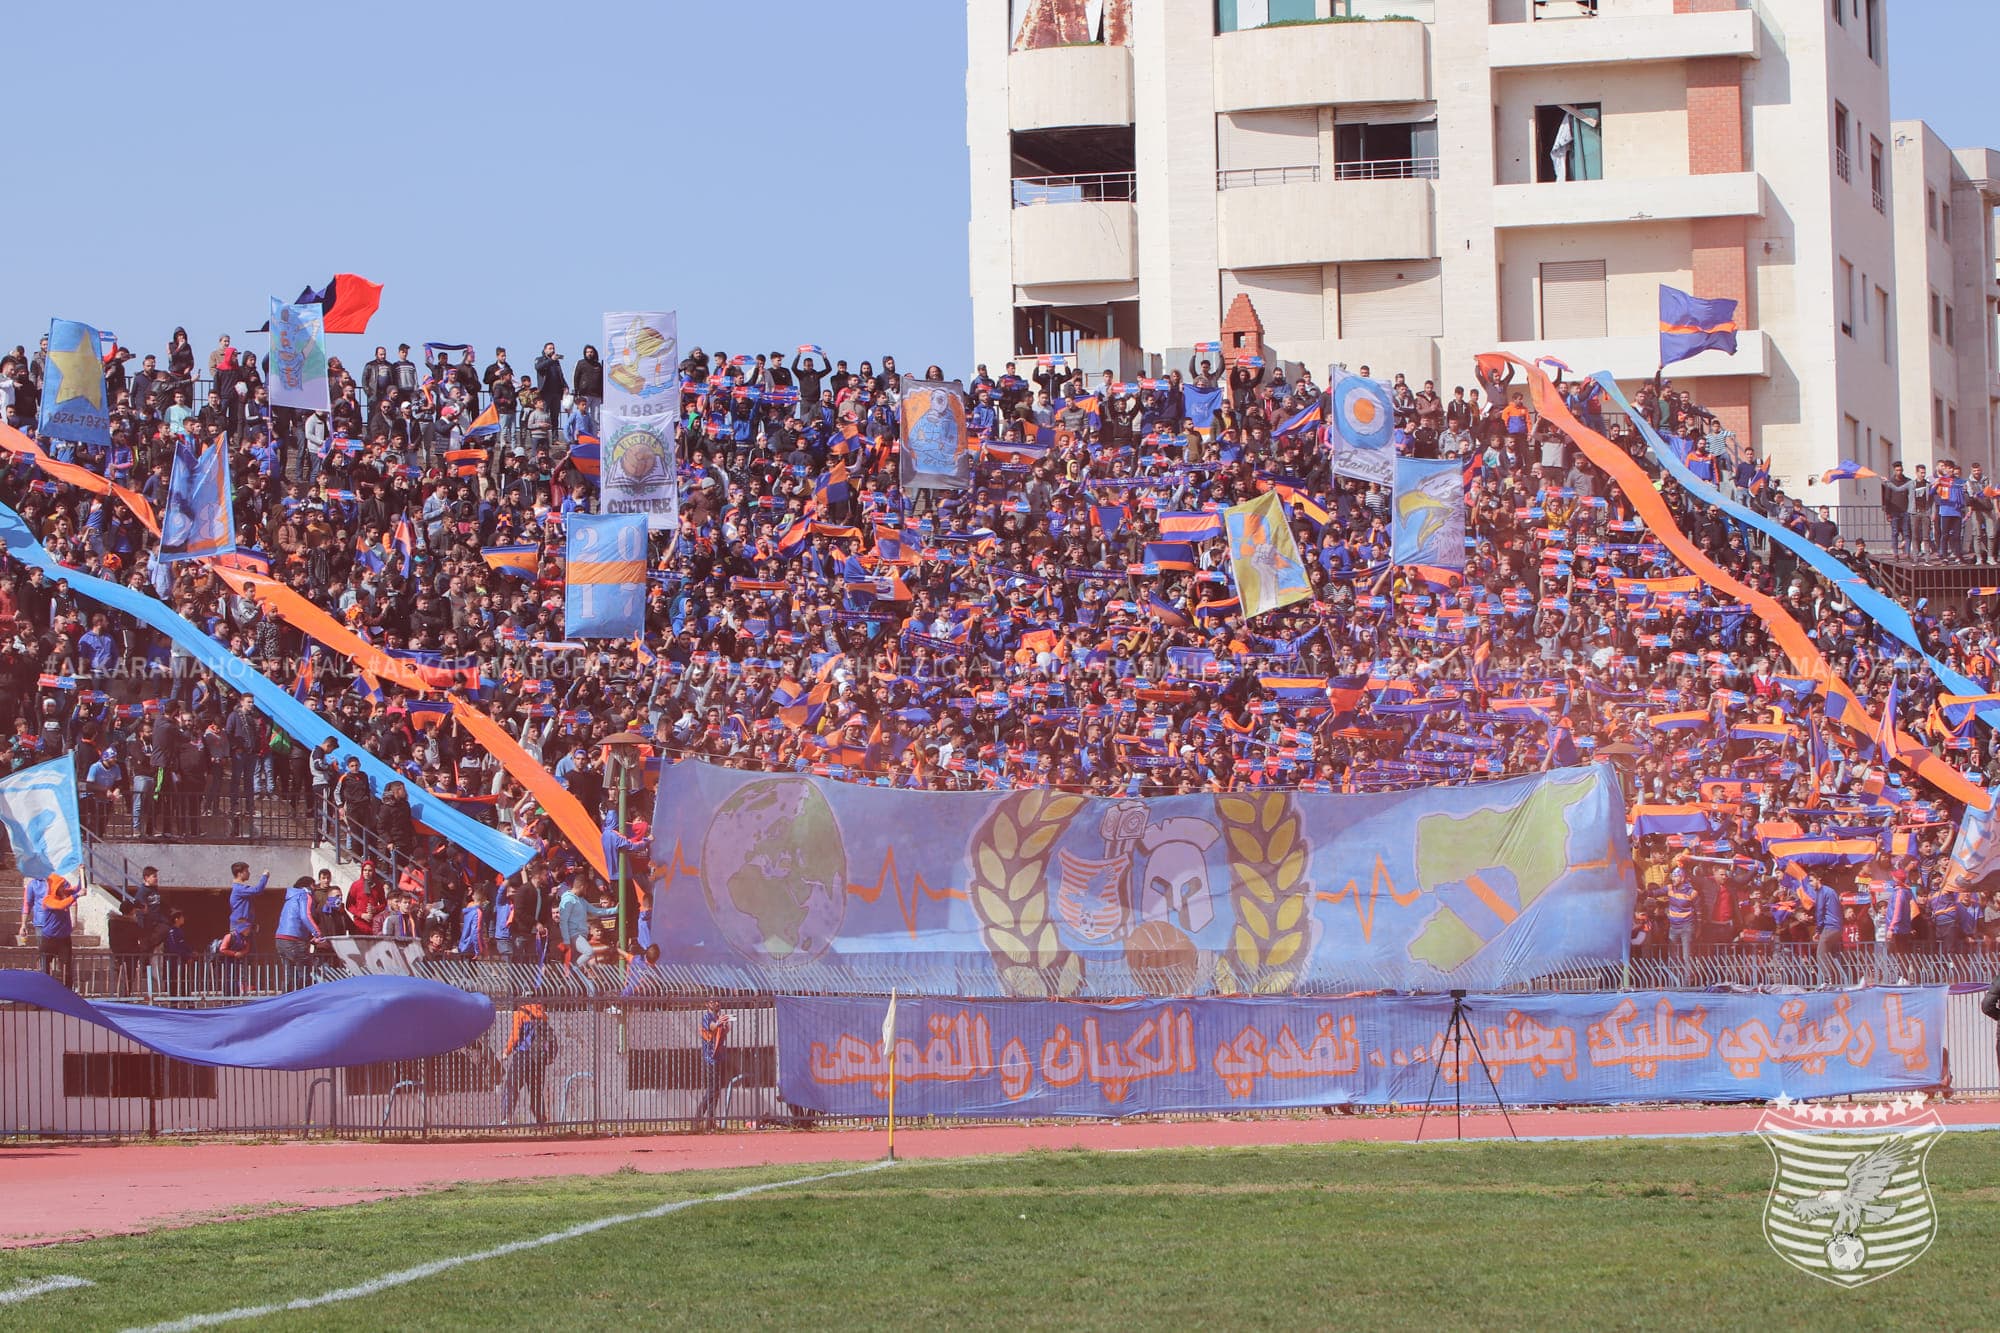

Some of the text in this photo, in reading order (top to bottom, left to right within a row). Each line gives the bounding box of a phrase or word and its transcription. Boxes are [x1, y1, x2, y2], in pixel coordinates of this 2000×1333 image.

[607, 498, 671, 514] CULTURE
[810, 1009, 994, 1099] القميص
[999, 1035, 1033, 1100] و
[1040, 1006, 1197, 1104] الكيان
[1213, 1012, 1361, 1099] نفدي
[1586, 998, 1713, 1079] خليك
[1717, 993, 1876, 1079] رفيقي
[1884, 993, 1930, 1071] يا
